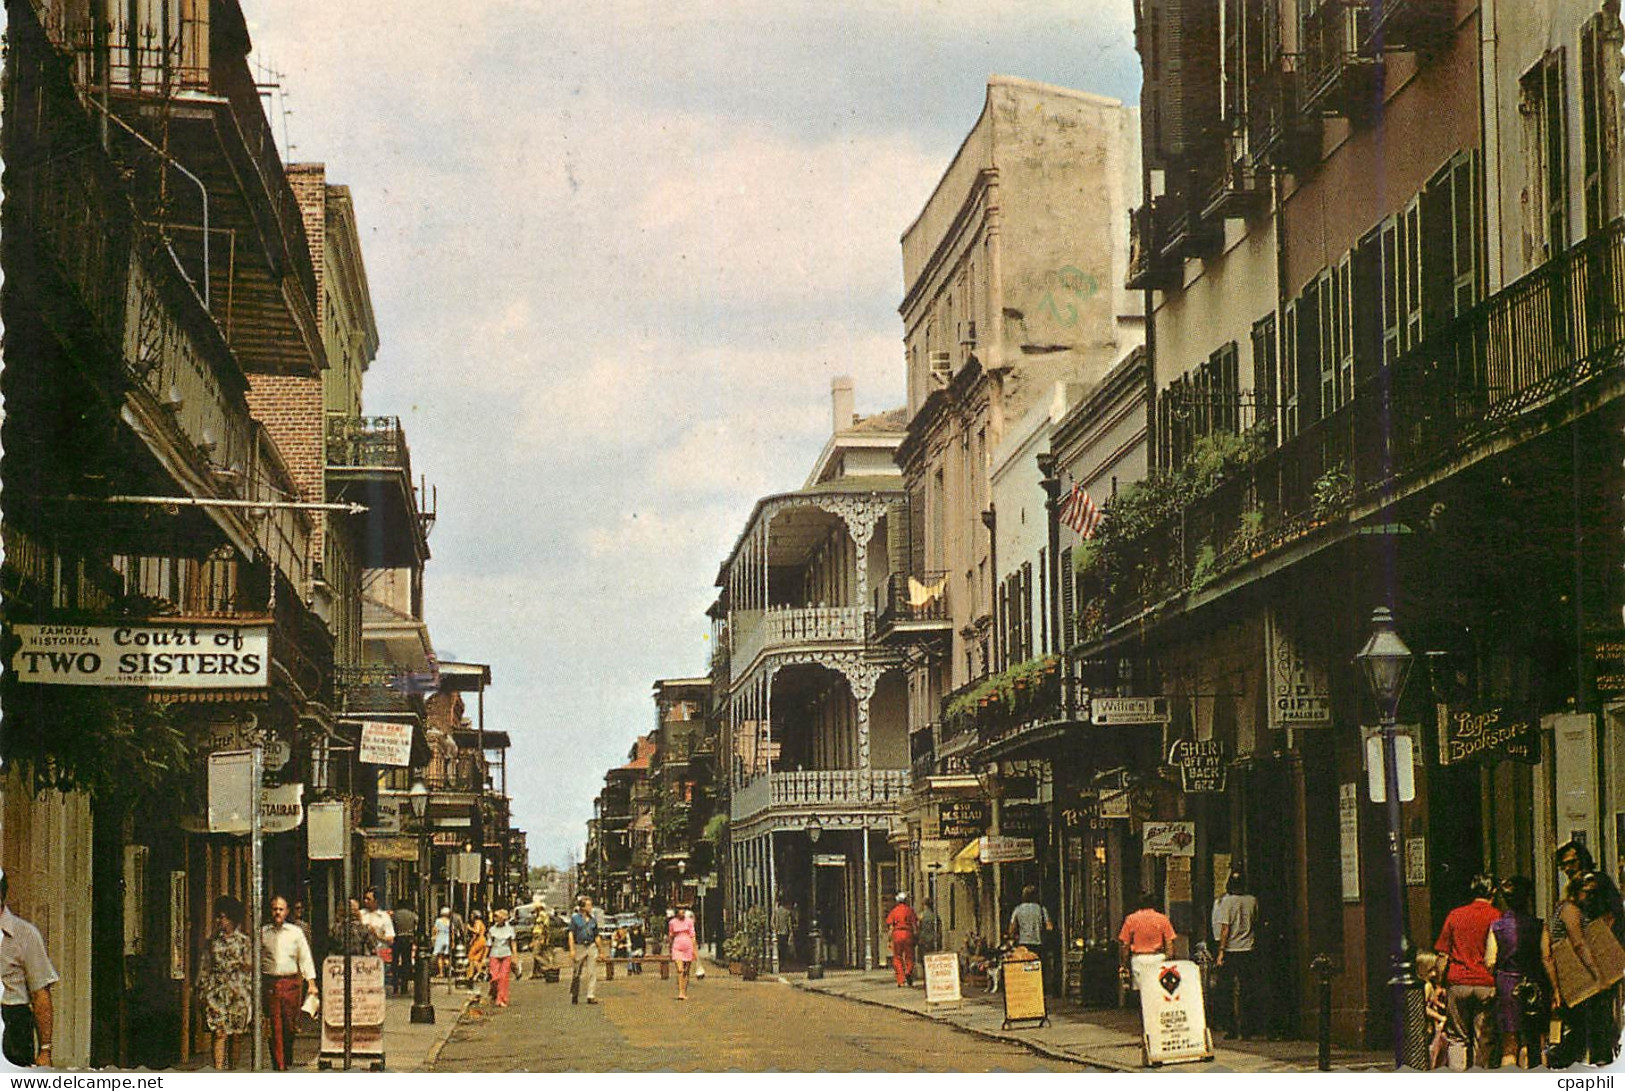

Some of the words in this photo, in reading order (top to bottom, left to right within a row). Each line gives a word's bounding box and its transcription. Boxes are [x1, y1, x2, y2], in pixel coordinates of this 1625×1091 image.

[40, 627, 89, 636] FAMOUS
[30, 637, 100, 646] HISTORICAL
[113, 627, 200, 646] Court
[213, 627, 243, 651] of
[21, 651, 102, 674] TWO
[118, 653, 260, 675] SISTERS
[1450, 722, 1529, 760] Bookstore
[1206, 757, 1220, 766] MY
[1189, 767, 1219, 778] BACK
